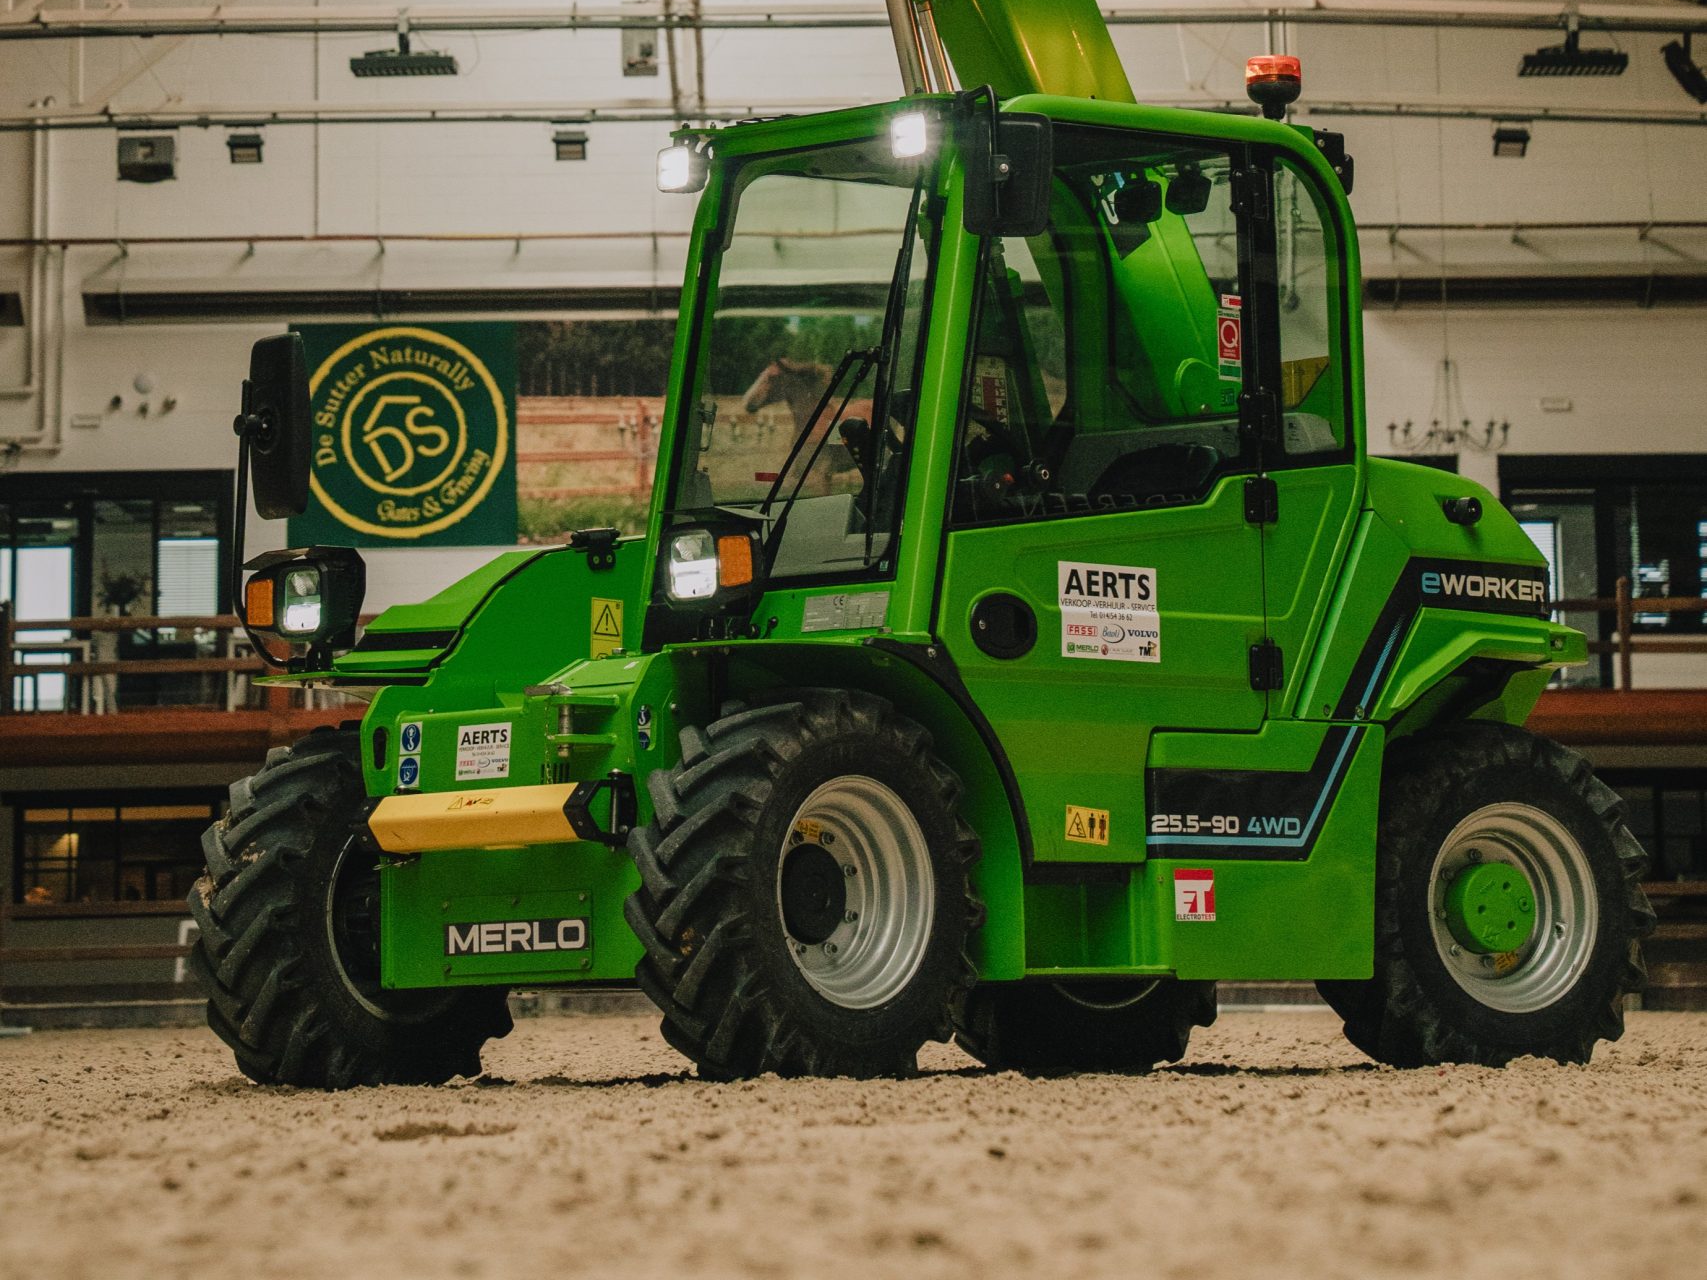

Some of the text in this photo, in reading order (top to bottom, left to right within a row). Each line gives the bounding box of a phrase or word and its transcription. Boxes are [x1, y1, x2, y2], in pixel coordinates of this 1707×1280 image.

[315, 346, 475, 468] De Sutter Naturally
[1064, 569, 1150, 600] AERTS
[1421, 572, 1545, 602] eWORKER
[1060, 599, 1092, 608] VERKOOP
[1131, 603, 1156, 612] SERVICE
[1068, 625, 1097, 636] FASSI
[1128, 629, 1158, 639] VOLVO
[1076, 644, 1099, 653] MERLO
[461, 729, 507, 745] AERTS
[1151, 814, 1300, 835] 25.5-90 4WD
[448, 919, 585, 954] MERLO
